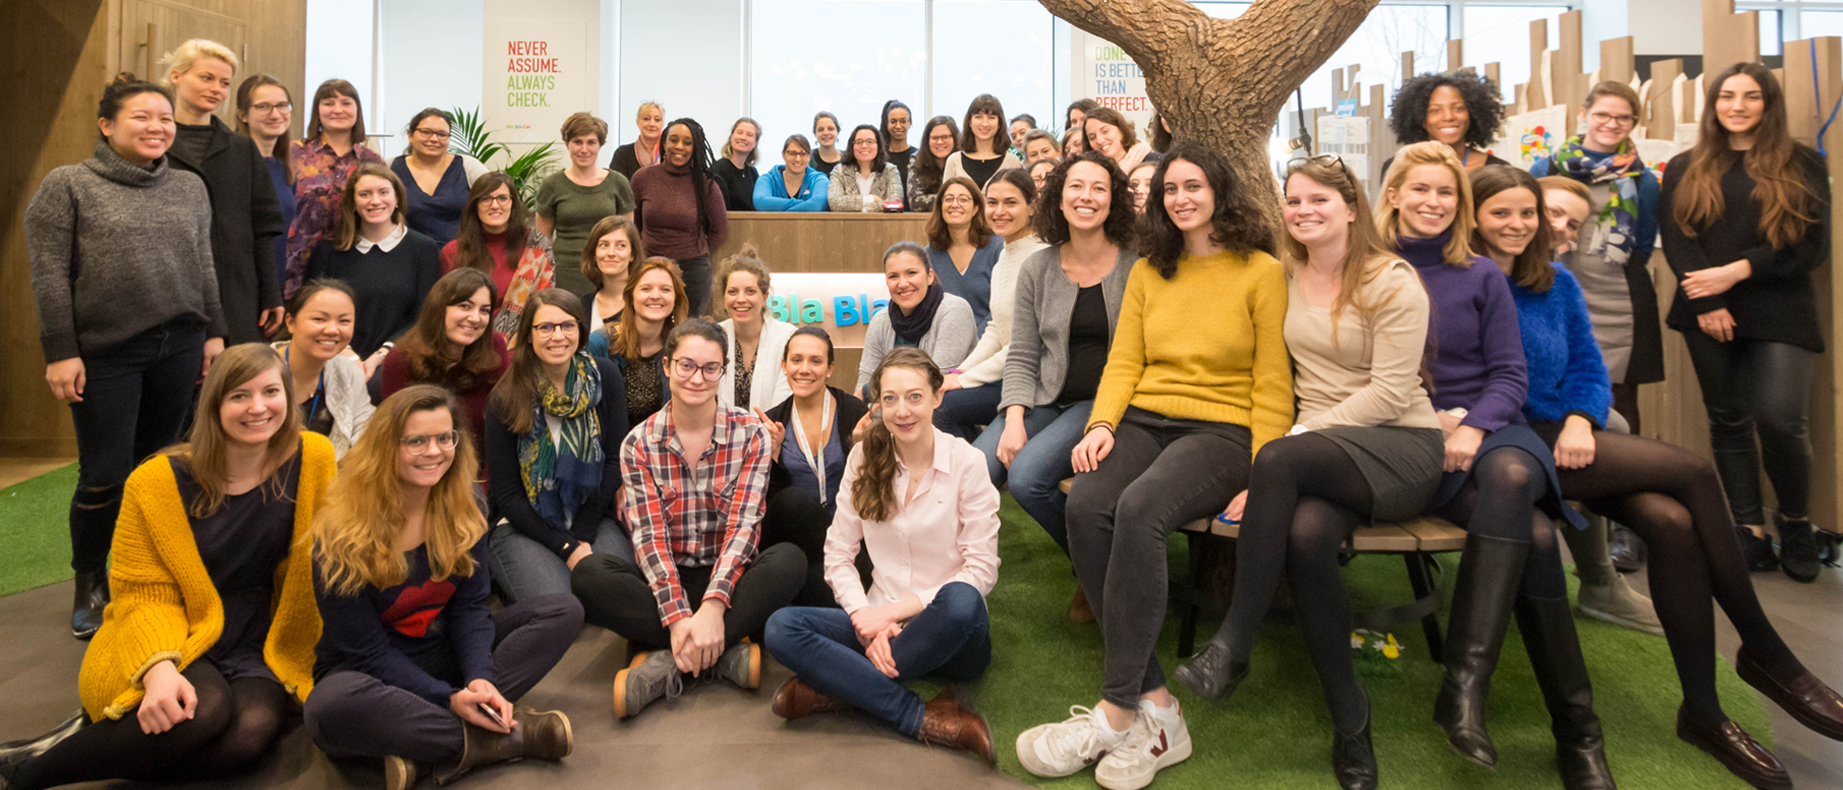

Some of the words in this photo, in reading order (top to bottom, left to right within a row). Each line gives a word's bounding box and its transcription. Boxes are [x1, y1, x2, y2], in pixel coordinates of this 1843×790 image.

[508, 41, 547, 55] NEVER
[507, 58, 562, 73] ASSUME.
[1095, 63, 1107, 78] IS
[1109, 63, 1144, 78] BETTE
[507, 75, 555, 90] ALWAYS
[1096, 80, 1126, 94] THAN
[507, 92, 551, 107] CHECK.
[1095, 96, 1148, 111] PERFECT.
[766, 293, 824, 324] Bla
